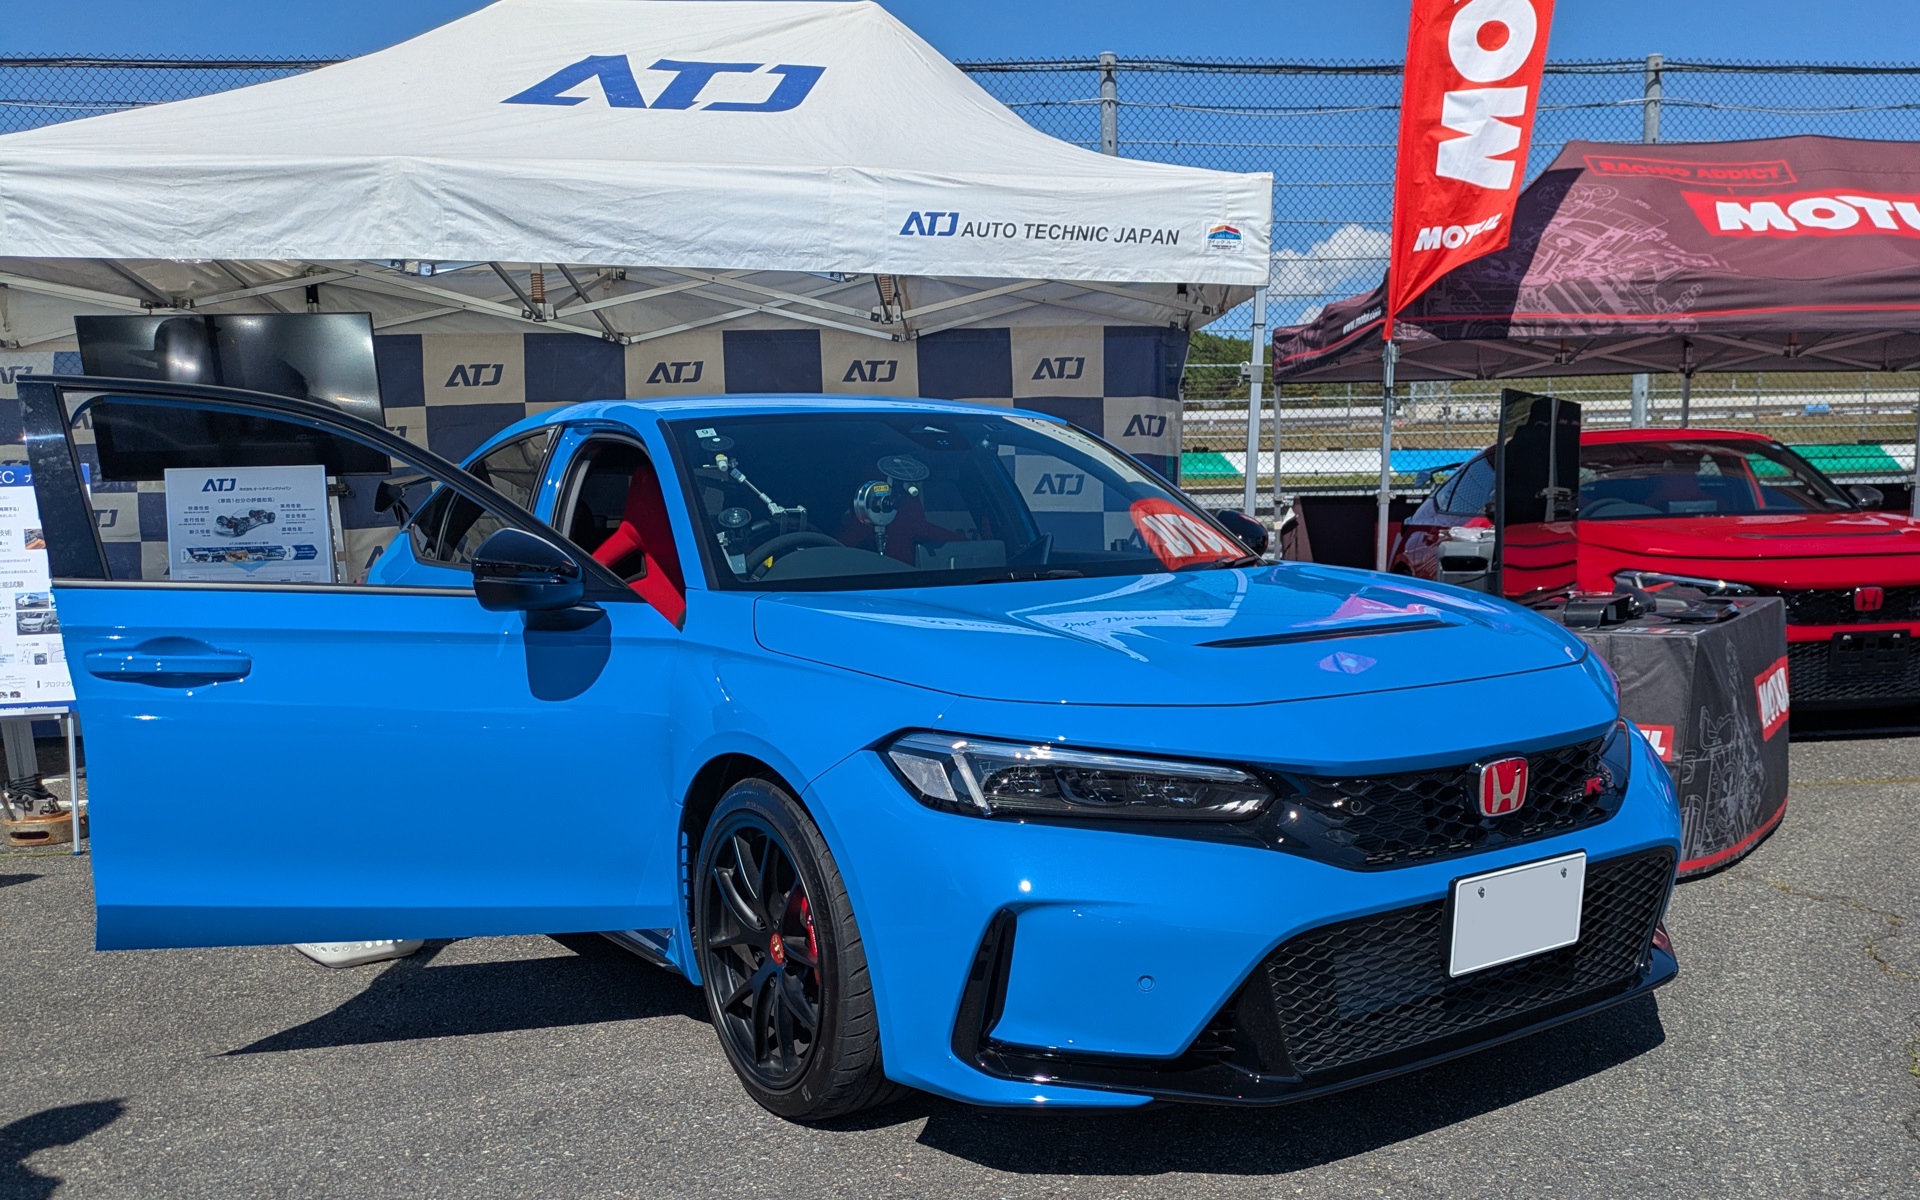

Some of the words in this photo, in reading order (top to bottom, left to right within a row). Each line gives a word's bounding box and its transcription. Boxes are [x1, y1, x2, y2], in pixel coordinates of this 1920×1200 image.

[499, 54, 828, 113] ATJ
[1599, 161, 1691, 177] RACING
[1697, 166, 1779, 180] ADDICT
[899, 211, 960, 237] ATJ
[961, 221, 1017, 239] AUTO
[1023, 223, 1109, 243] TECHNIC
[1114, 228, 1180, 246] JAPAN
[1412, 211, 1503, 253] MOTUL
[444, 364, 504, 387] ATJ
[646, 360, 704, 384] ATJ
[842, 359, 898, 382] ATJ
[1031, 357, 1085, 380] ATJ
[1122, 413, 1166, 437] ATJ
[201, 478, 237, 492] ATJ
[1033, 473, 1085, 495] ATJ
[93, 509, 119, 528] TJ
